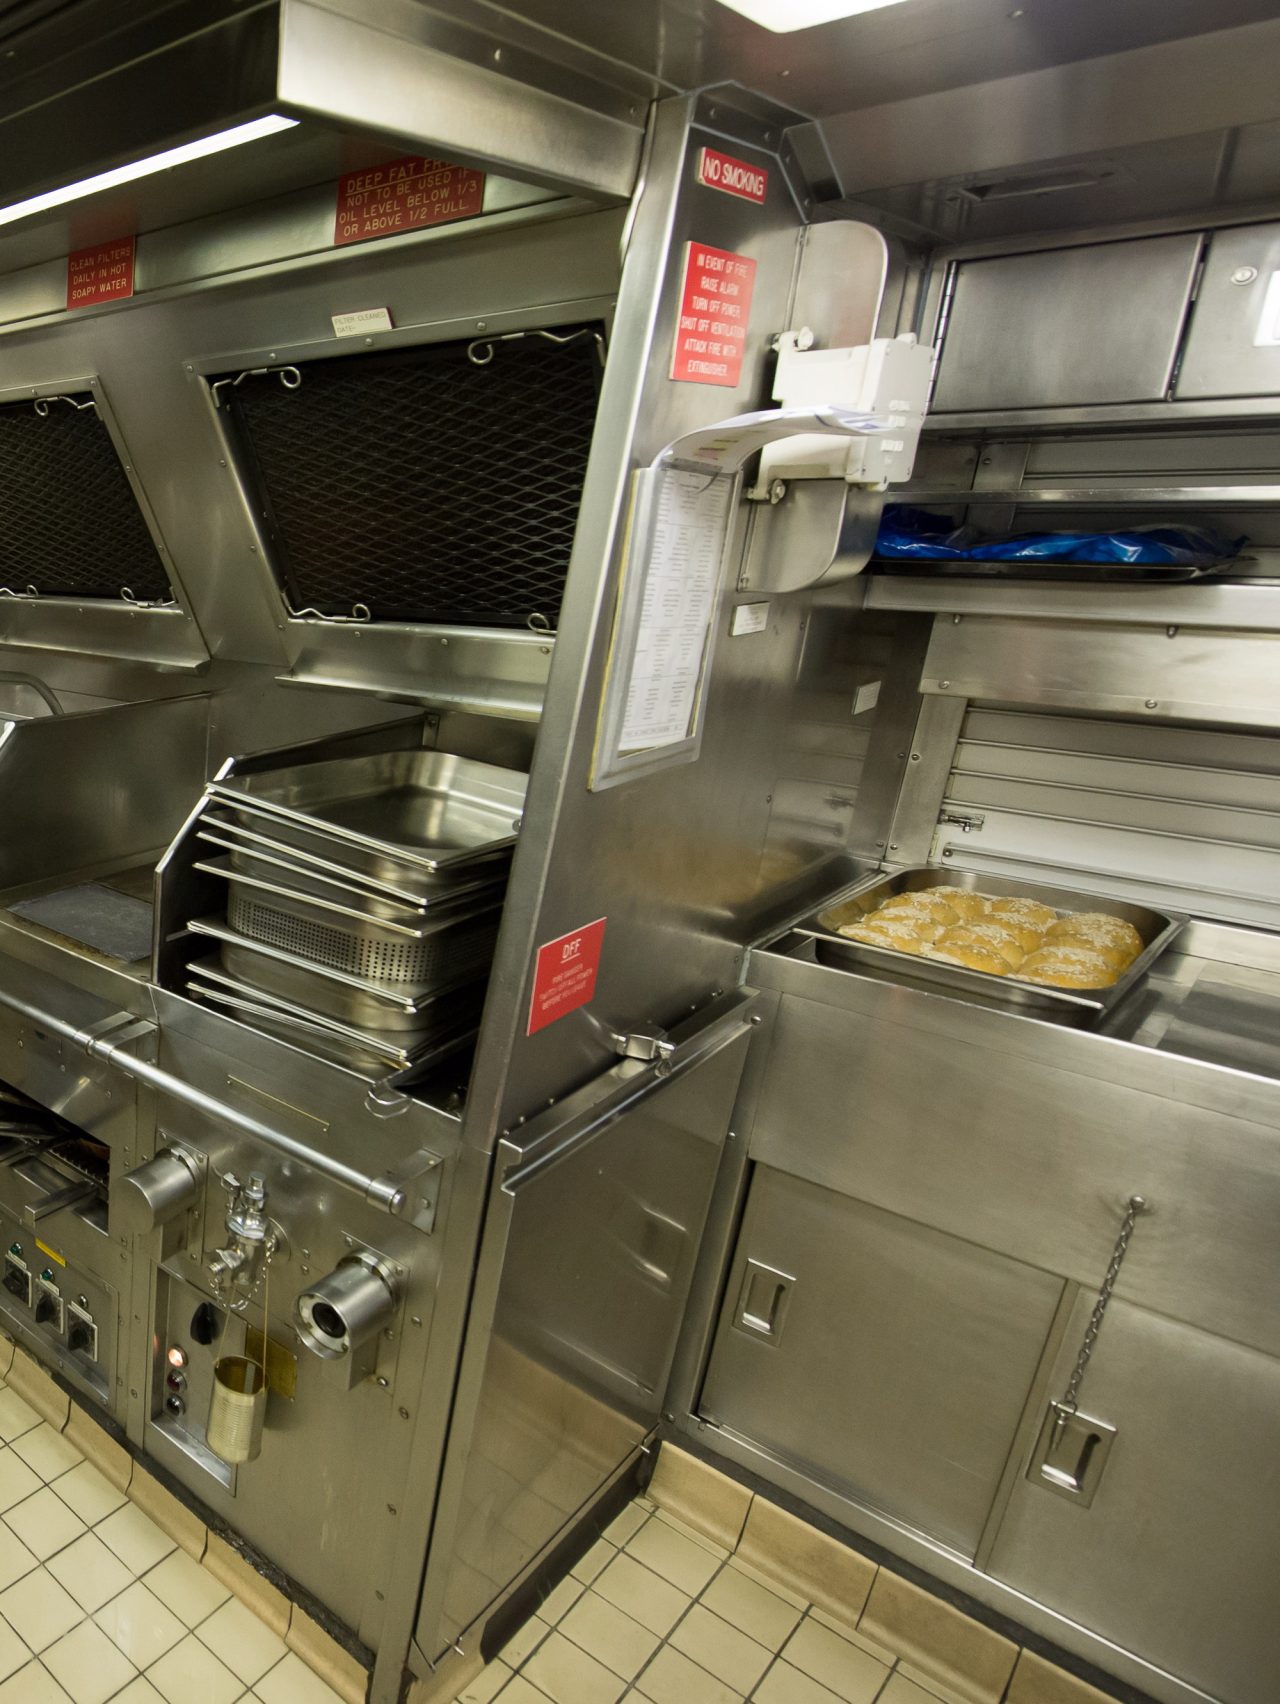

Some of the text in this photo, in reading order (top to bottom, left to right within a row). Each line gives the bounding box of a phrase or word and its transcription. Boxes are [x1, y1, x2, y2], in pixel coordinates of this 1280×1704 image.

[346, 192, 370, 208] NOT
[377, 187, 391, 200] TO
[397, 181, 412, 195] BE
[418, 171, 452, 189] USED
[347, 173, 383, 193] DEEP
[389, 163, 417, 183] FAT
[704, 157, 764, 196] NO SMOKING
[339, 180, 478, 224] OIL LEVEL BELOW 1/3
[343, 200, 469, 236] OR ABOVE 1/2 FULL
[70, 247, 131, 271] CLEAN FILTERS
[73, 263, 126, 285] DAILY IN HOT
[72, 278, 127, 300] SOAPY WATER
